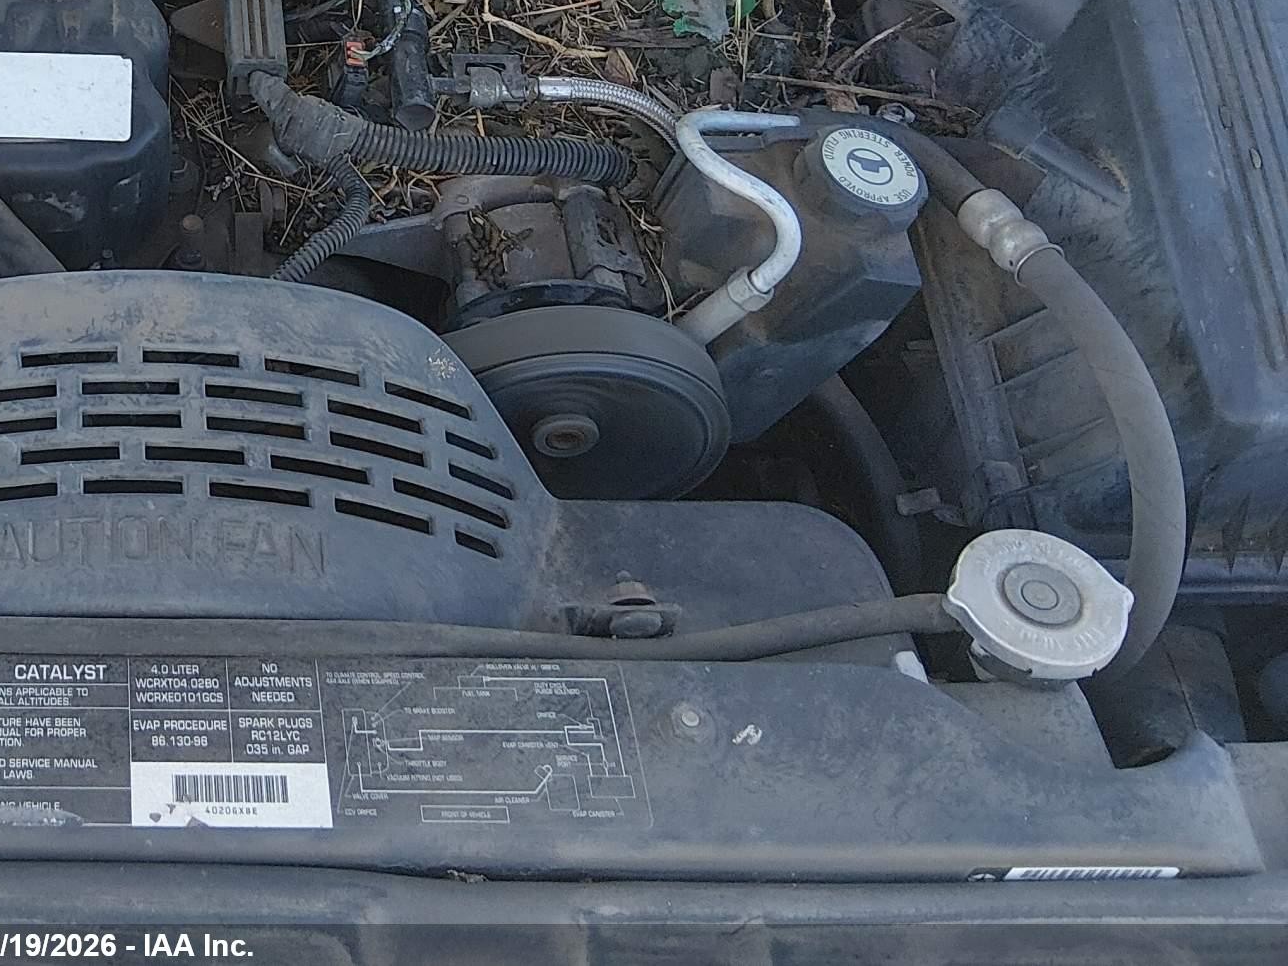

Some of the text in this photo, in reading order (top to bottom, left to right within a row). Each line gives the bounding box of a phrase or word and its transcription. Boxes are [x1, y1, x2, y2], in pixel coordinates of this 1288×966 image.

[824, 129, 917, 178] POWER STEERING FLUID
[838, 176, 912, 203] USE APPROVED
[14, 664, 107, 681] CATALYST
[150, 665, 200, 675] 4.0 LITER
[261, 663, 278, 673] NO
[234, 676, 313, 688] ADJUSTMENTS
[15, 687, 72, 696] APPLICABLE
[76, 687, 88, 696] TO
[252, 691, 295, 702] NEEDED
[17, 697, 72, 706] ALTITUDES.
[25, 718, 51, 727] HAVE
[54, 718, 80, 727] BEEN
[133, 720, 227, 731] EVAP PROCEDURE
[238, 717, 313, 728] SPARK PLUGS
[24, 728, 43, 737] FOR
[46, 728, 86, 737] PROPER
[272, 744, 283, 754] in.
[285, 744, 310, 754] GAP
[8, 758, 50, 768] SERVICE
[54, 758, 97, 768] MANUAL
